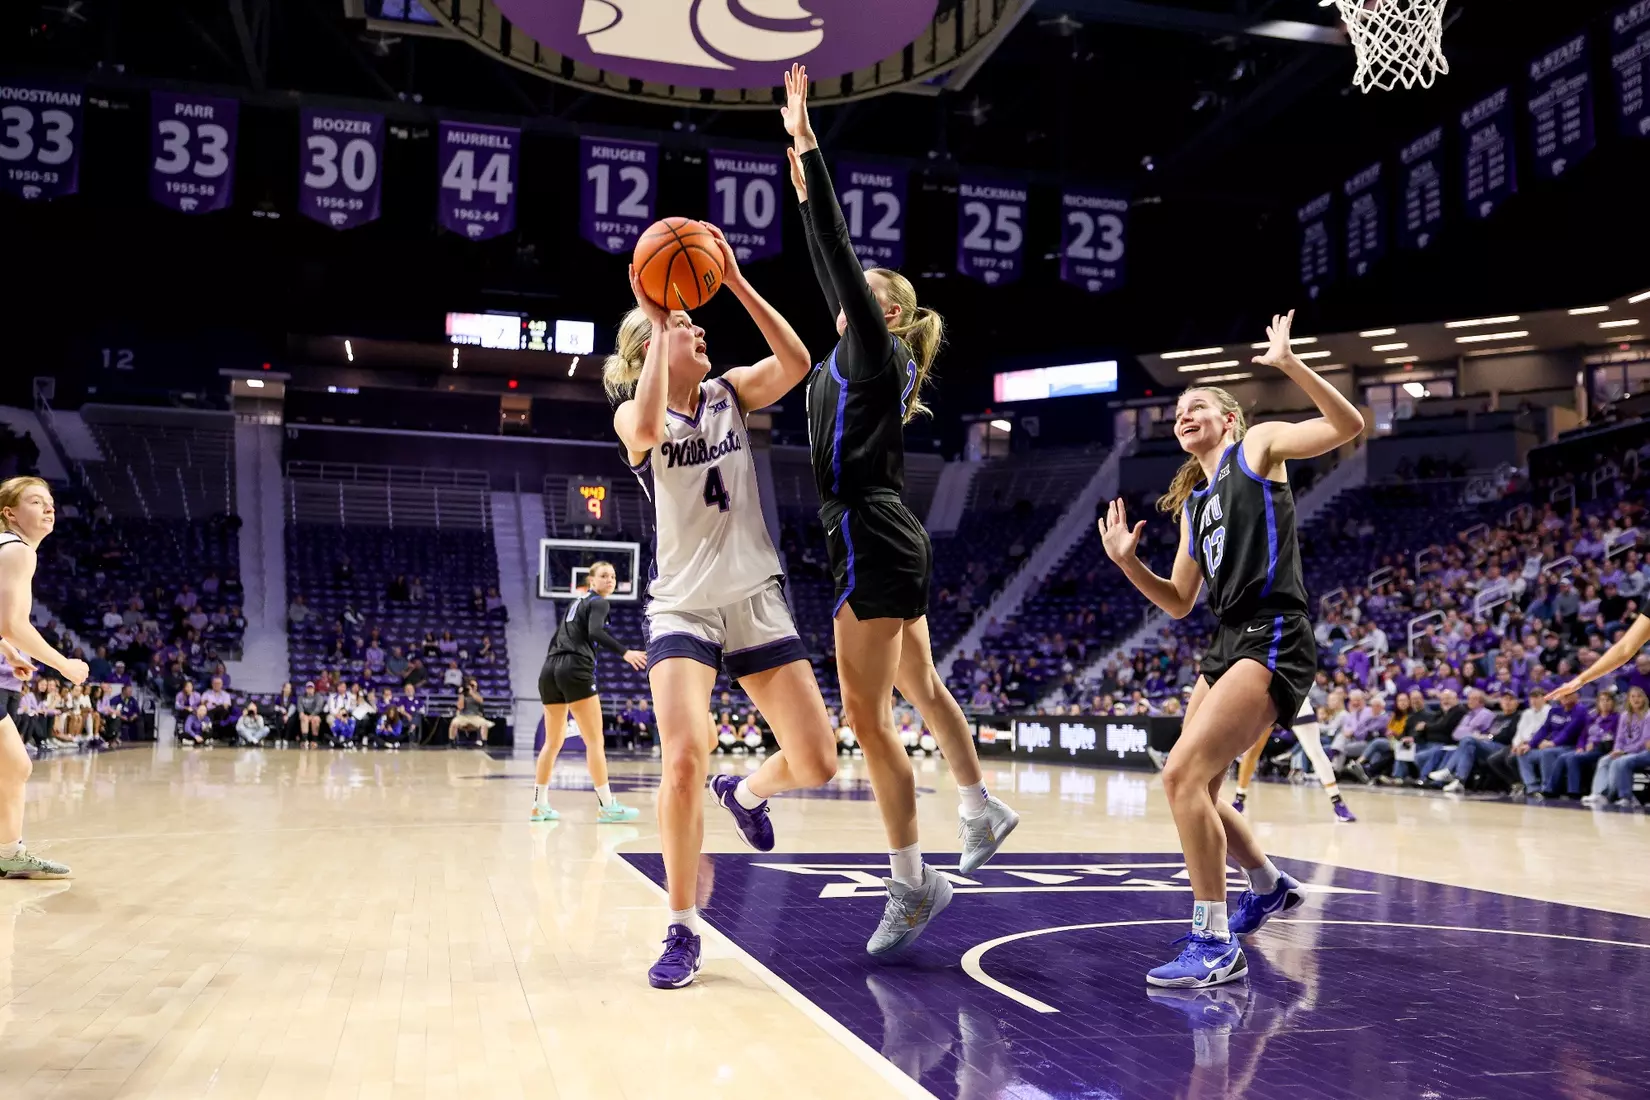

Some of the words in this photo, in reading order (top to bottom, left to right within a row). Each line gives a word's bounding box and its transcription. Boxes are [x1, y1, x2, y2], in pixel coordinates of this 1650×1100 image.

[0, 86, 81, 106] KNOSTMAN
[175, 103, 214, 119] PARR
[0, 105, 74, 164] 33
[313, 117, 371, 134] BOOZER
[154, 120, 229, 178] 33
[447, 131, 511, 149] MURRELL
[304, 135, 377, 192] 30
[592, 146, 645, 162] KRUGER
[8, 169, 58, 183] 1950-53
[714, 158, 777, 175] WILLIAMS
[442, 150, 513, 205] 44
[851, 172, 892, 187] EVANS
[166, 181, 215, 196] 1955-58
[587, 164, 649, 218] 12
[959, 184, 1026, 202] BLACKMAN
[316, 196, 363, 210] 1956-59
[714, 176, 775, 229] 10
[1062, 194, 1128, 212] RICHMOND
[453, 208, 499, 222] 1962-64
[842, 189, 900, 241] 12
[594, 221, 638, 236] 1971-74
[963, 201, 1023, 253] 25
[1066, 211, 1125, 262] 23
[101, 347, 136, 370] 12
[703, 465, 730, 513] 4
[588, 498, 601, 519] 9
[1203, 525, 1225, 579] 13
